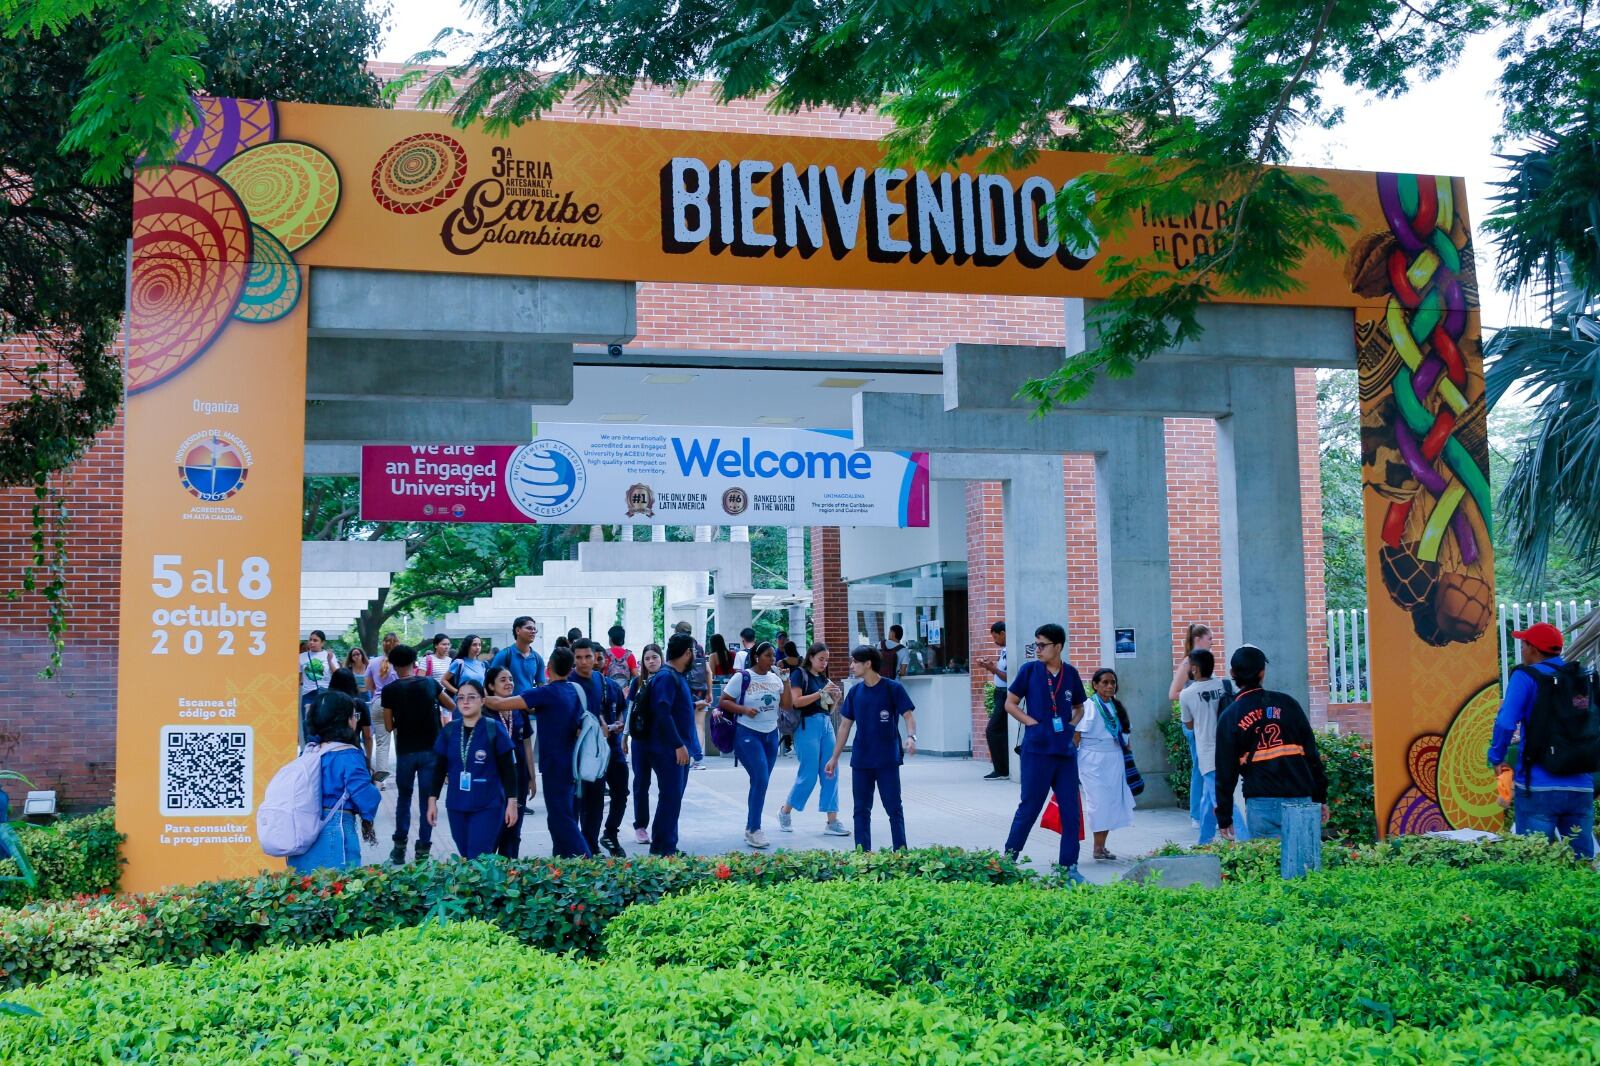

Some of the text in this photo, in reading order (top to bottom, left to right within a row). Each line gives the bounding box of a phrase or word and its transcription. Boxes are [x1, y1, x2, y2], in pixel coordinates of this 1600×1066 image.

[506, 159, 553, 179] FERIA
[506, 178, 551, 188] ARTESANAL Y
[506, 188, 553, 198] CULTURAL DEL
[464, 178, 602, 228] Caribe
[1141, 199, 1236, 230] TENZA
[439, 206, 603, 256] Colombiano
[1172, 233, 1225, 270] CO
[193, 399, 239, 415] Organiza
[622, 434, 667, 442] internationally
[443, 445, 475, 455] are
[640, 443, 667, 451] Engaged
[584, 450, 615, 458] University
[671, 437, 871, 480] Welcome
[587, 458, 601, 466] high
[385, 458, 496, 480] an Engaged
[391, 478, 496, 502] University!
[632, 493, 647, 504] #1
[658, 493, 708, 502] THE ONLY ONE IN
[728, 495, 742, 503] #6
[753, 495, 795, 503] RANKED SIXTH
[659, 502, 706, 510] LATIN AMERICA
[753, 503, 796, 512] IN THE WORLD
[151, 554, 272, 600] 5 al 8
[152, 602, 267, 627] octubre
[178, 698, 237, 707] Escanea el
[179, 708, 236, 720] código QR
[1255, 723, 1283, 750] 12
[164, 823, 248, 833] Para consultar
[160, 833, 252, 847] la programación
